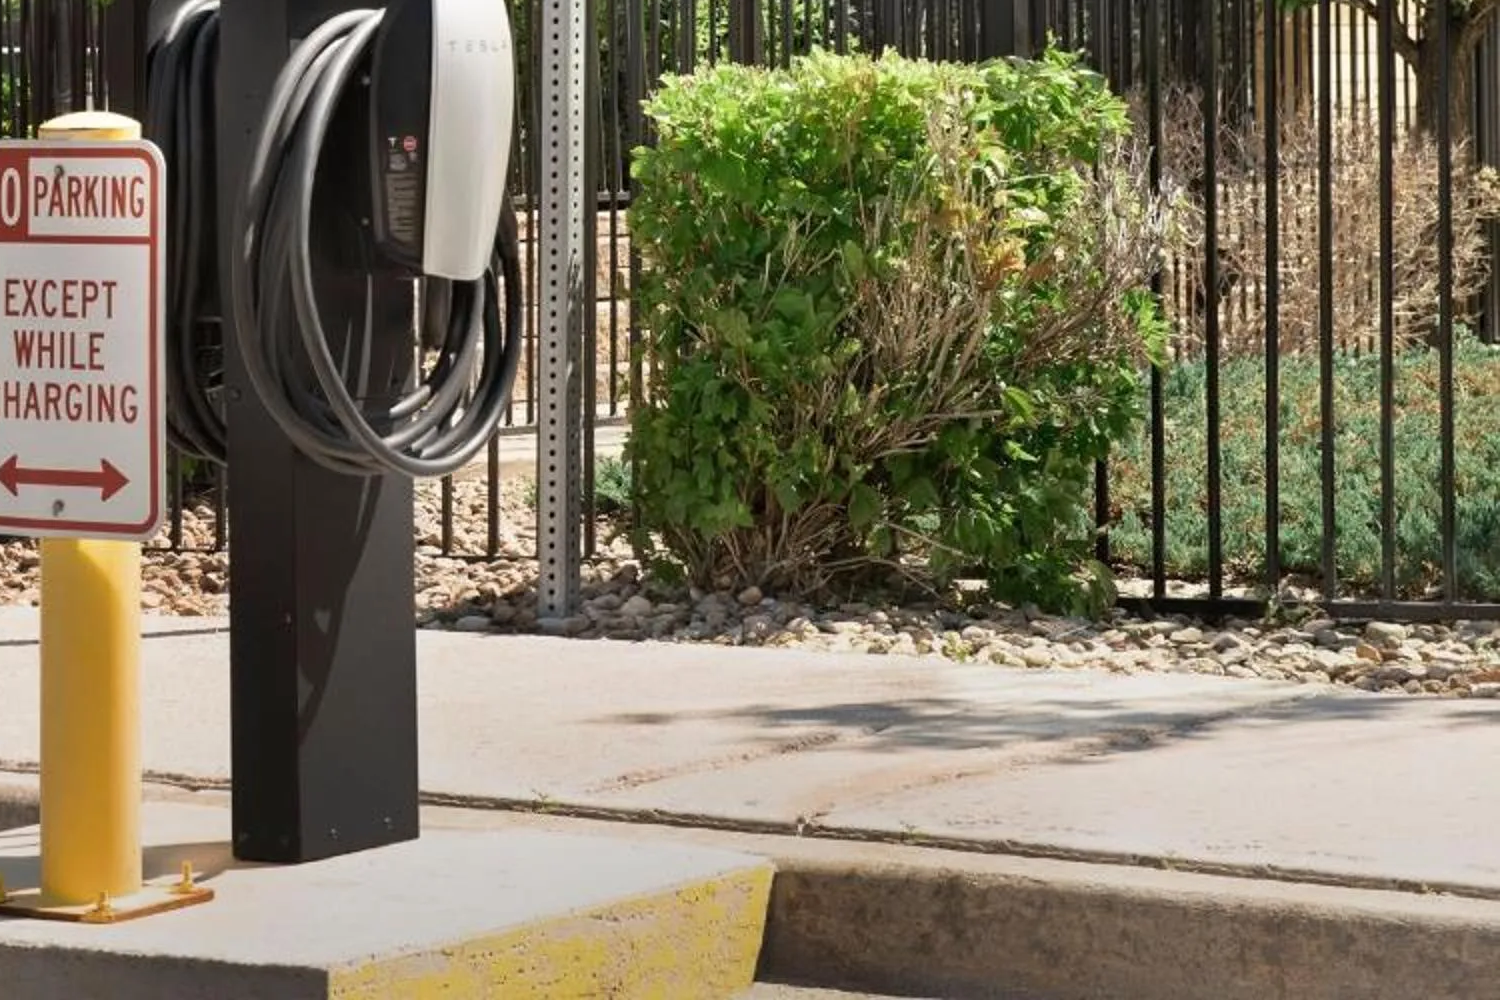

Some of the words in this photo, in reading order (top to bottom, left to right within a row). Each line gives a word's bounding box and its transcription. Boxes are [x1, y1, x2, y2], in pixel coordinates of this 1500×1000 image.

[33, 175, 145, 219] PARKING
[4, 279, 117, 318] EXCEPT
[14, 330, 105, 371] WHILE
